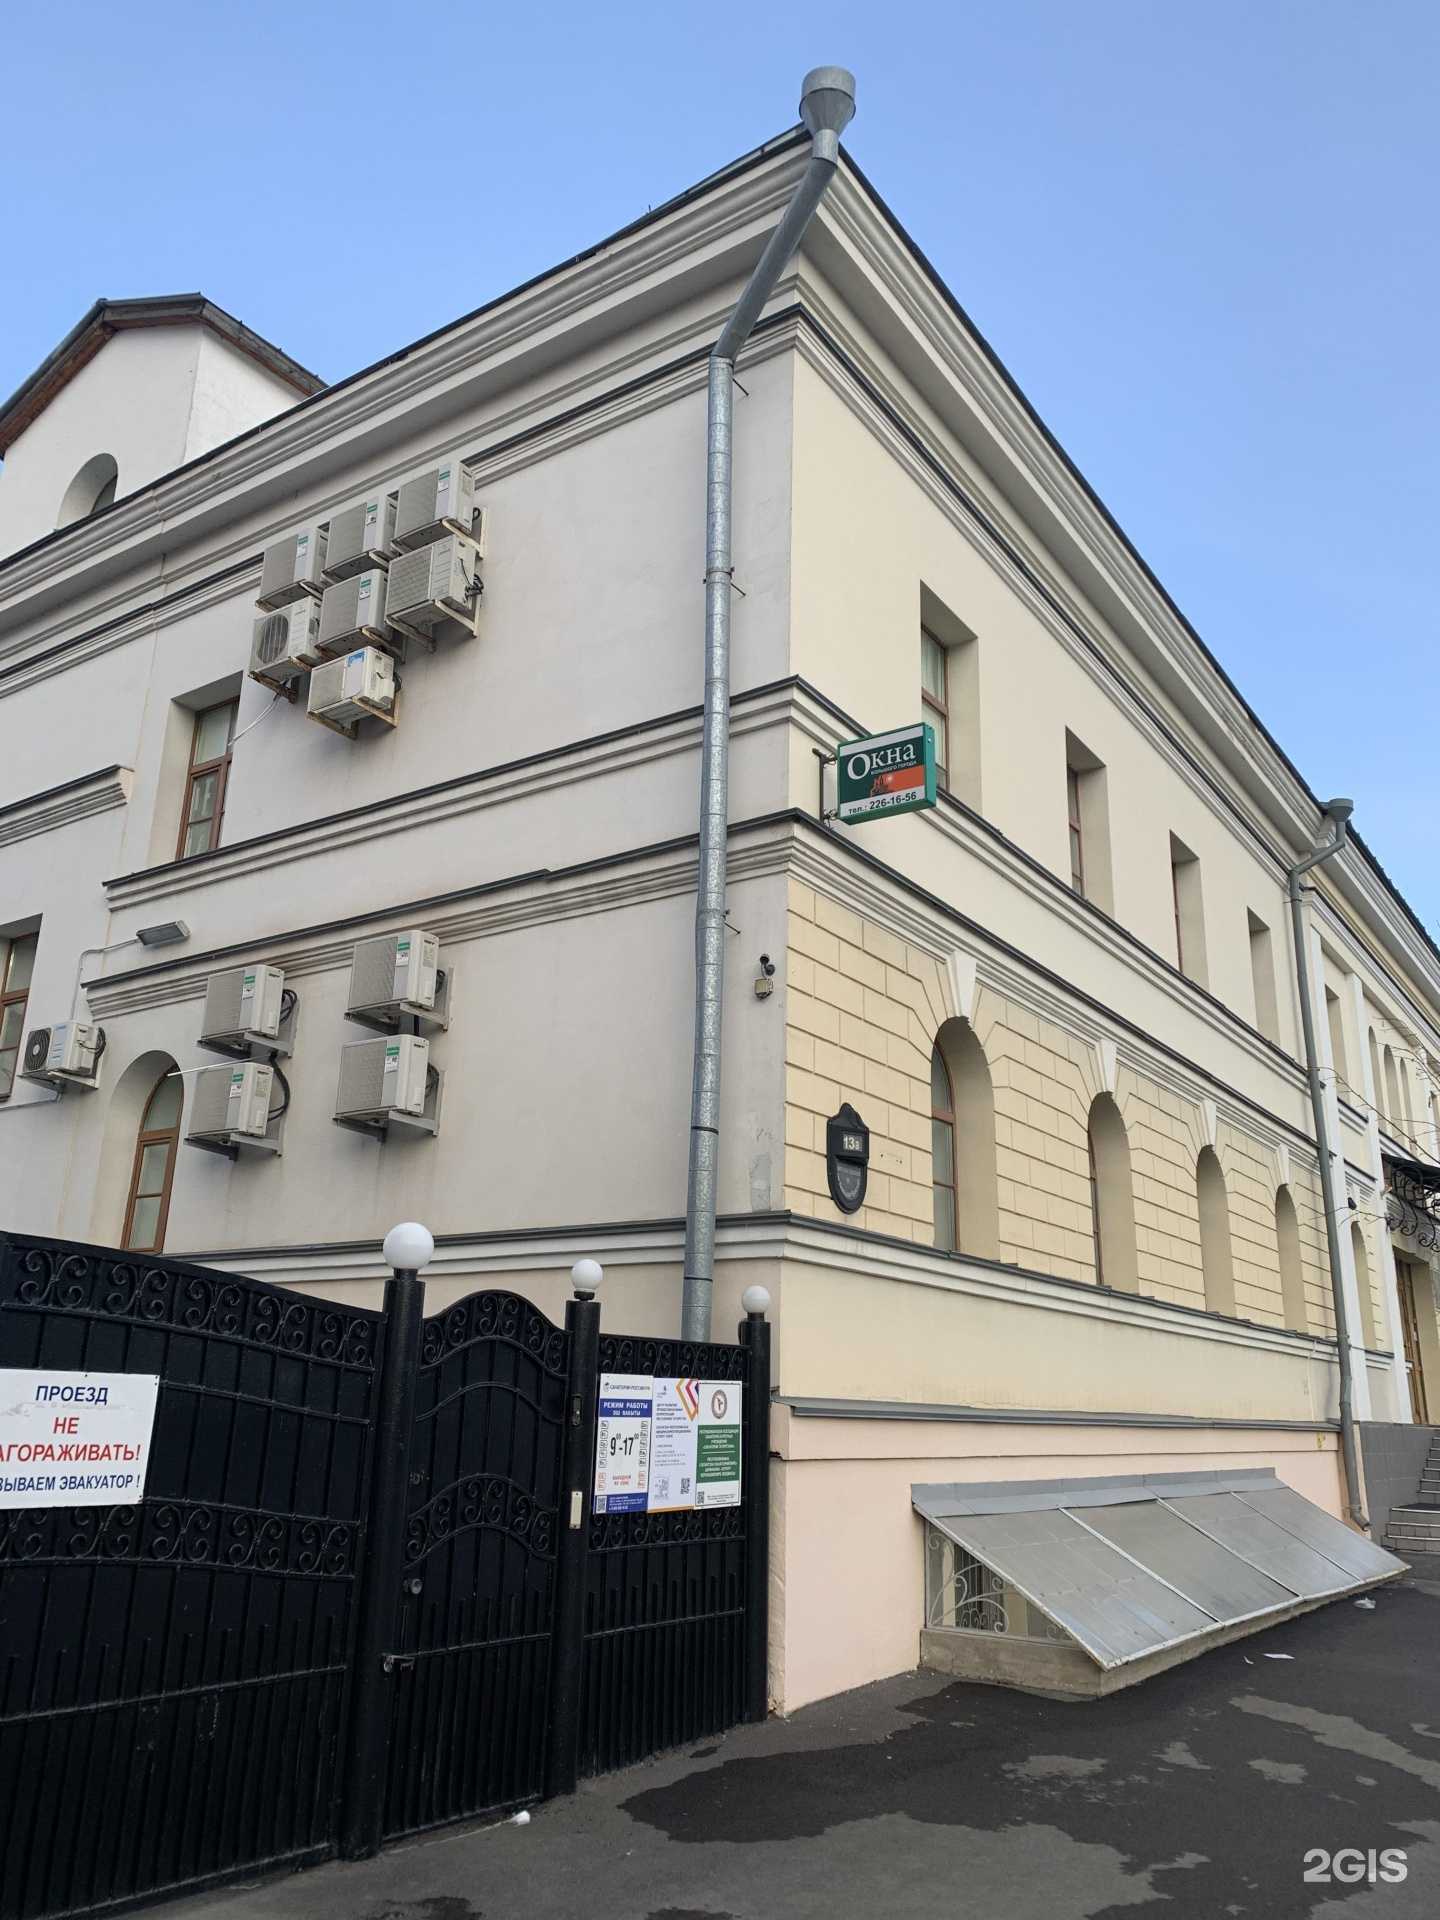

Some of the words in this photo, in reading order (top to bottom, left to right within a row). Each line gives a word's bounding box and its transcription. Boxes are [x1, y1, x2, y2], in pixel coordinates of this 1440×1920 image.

[847, 743, 916, 780] Окна
[869, 791, 917, 810] 226-16-56
[35, 1385, 108, 1405] ПРОЕЗД
[603, 1401, 624, 1409] РЕЖИМ
[52, 1416, 80, 1434] НЕ
